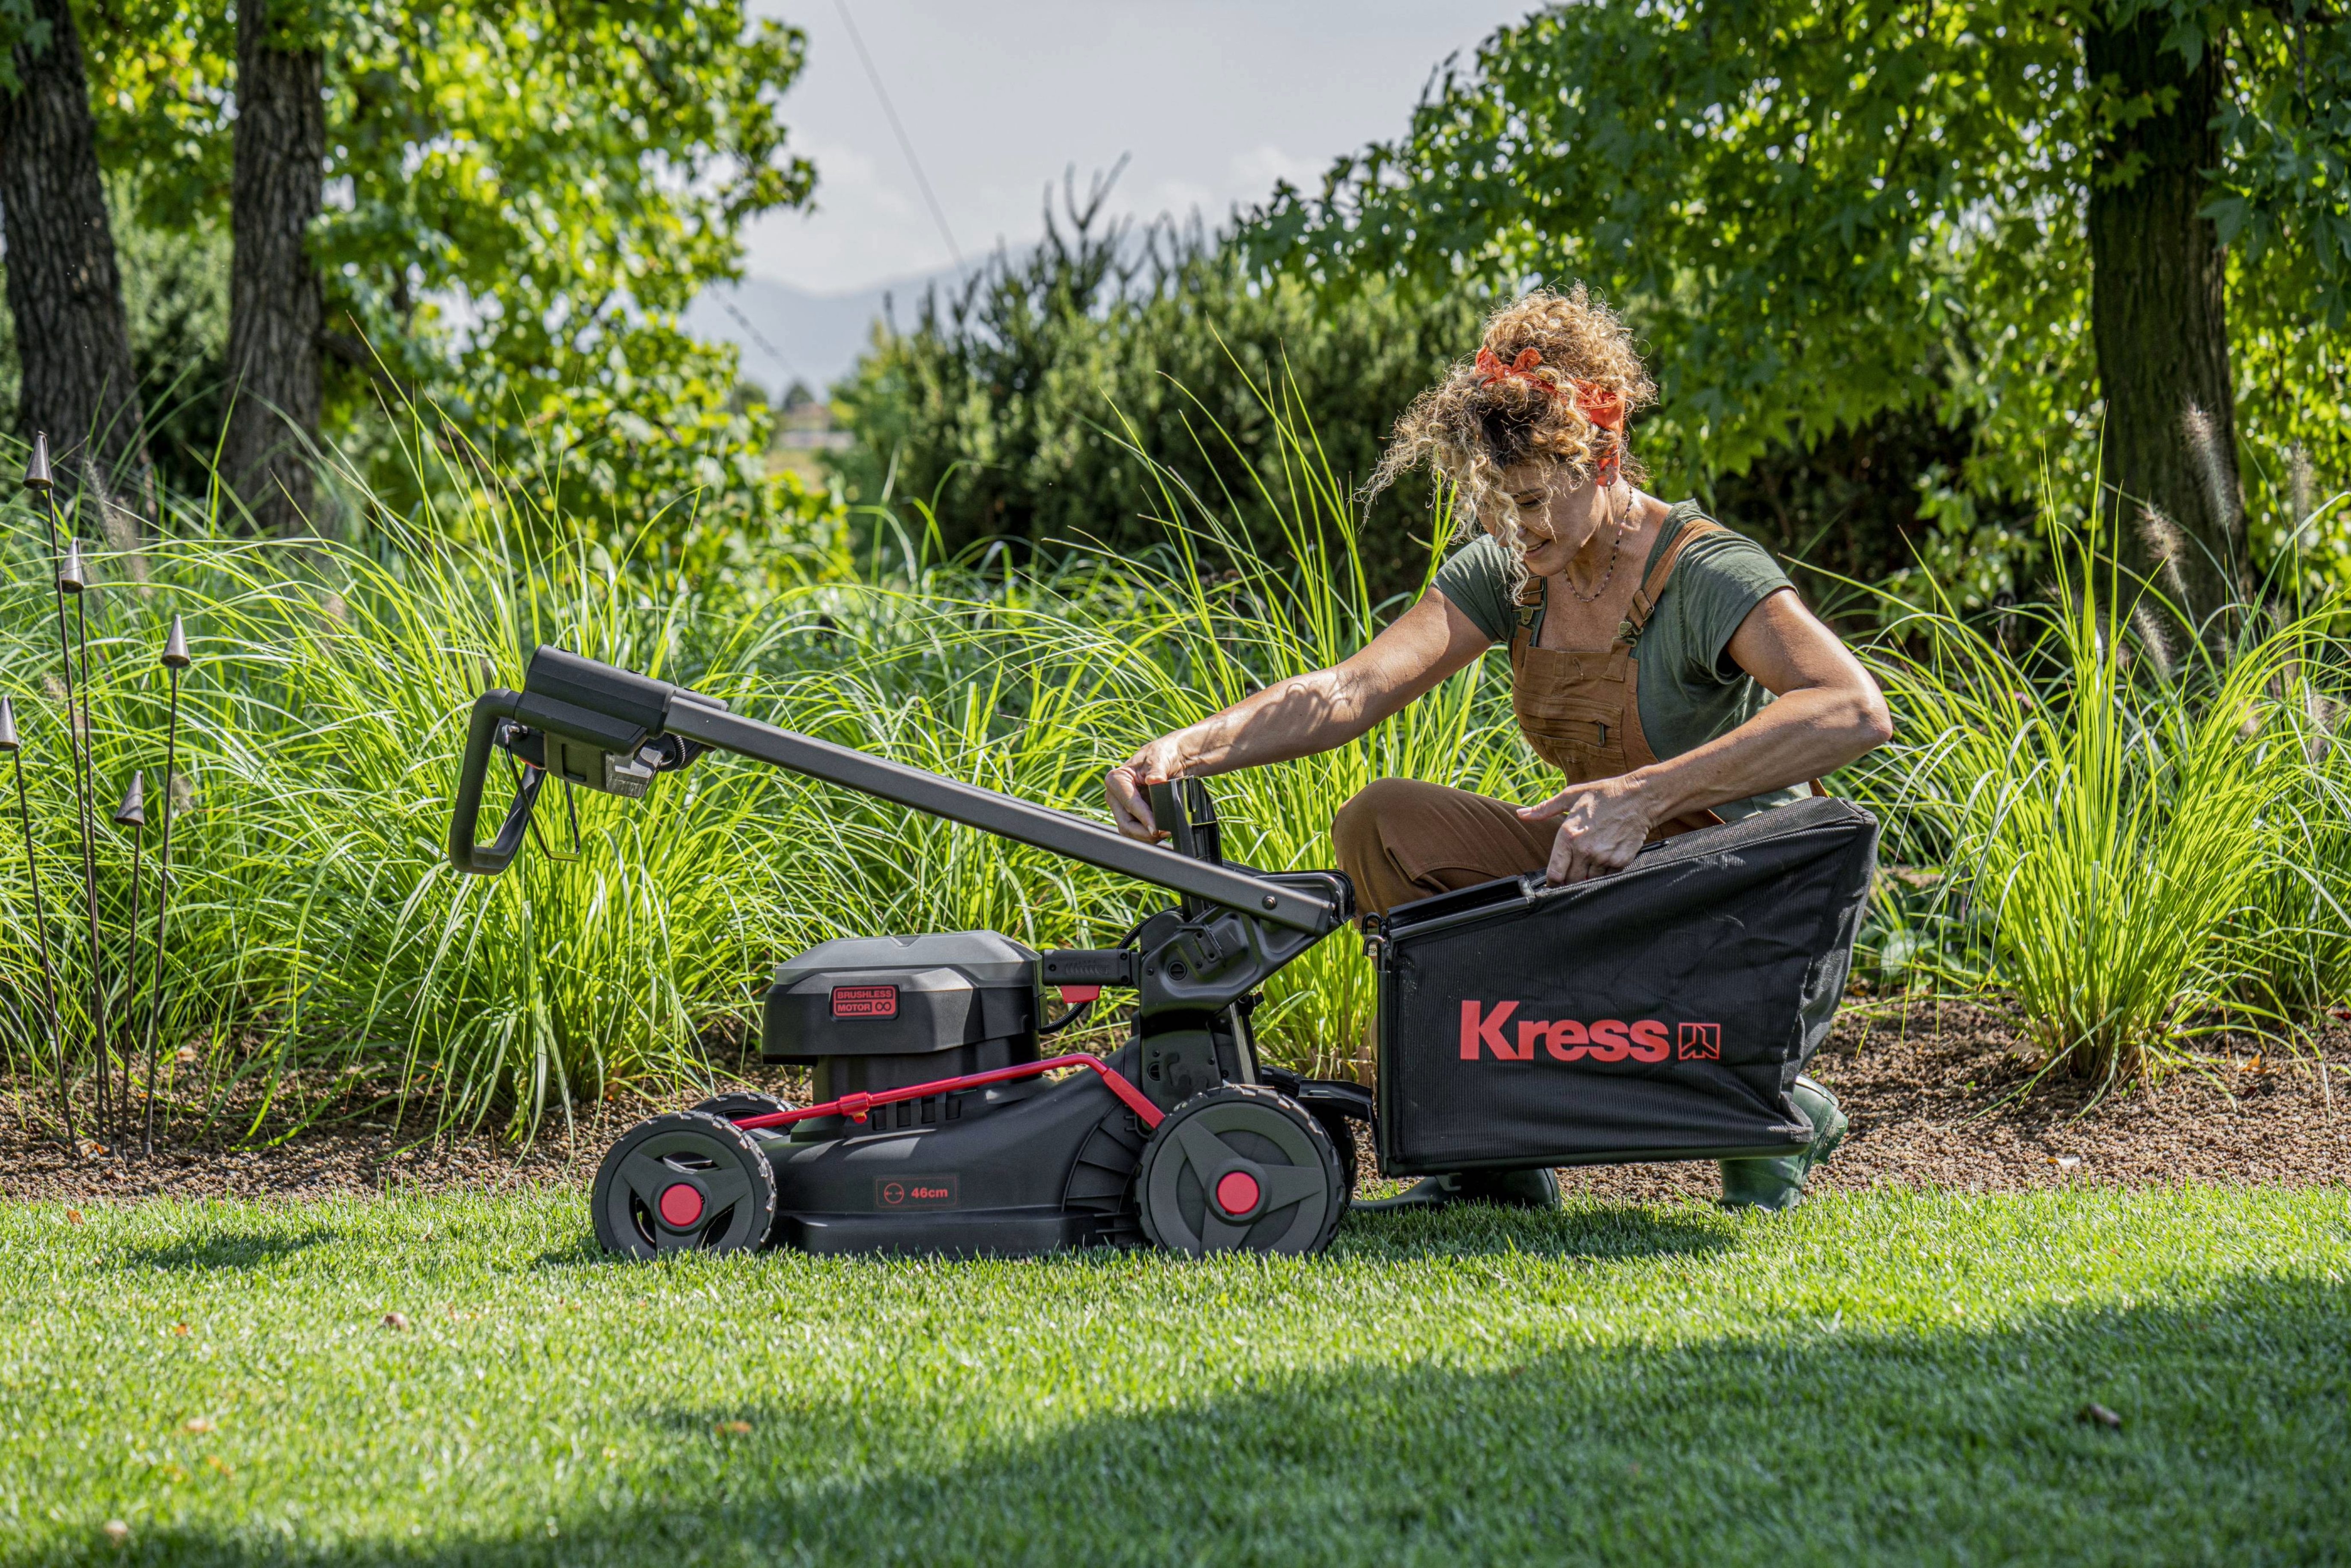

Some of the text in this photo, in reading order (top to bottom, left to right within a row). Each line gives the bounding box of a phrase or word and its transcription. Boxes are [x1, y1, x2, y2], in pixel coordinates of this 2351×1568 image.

[837, 990, 892, 999] BRUSHLESS
[837, 1004, 871, 1012] MOTOR
[1460, 1000, 1670, 1063] Kress
[911, 1187, 948, 1198] 46cm
